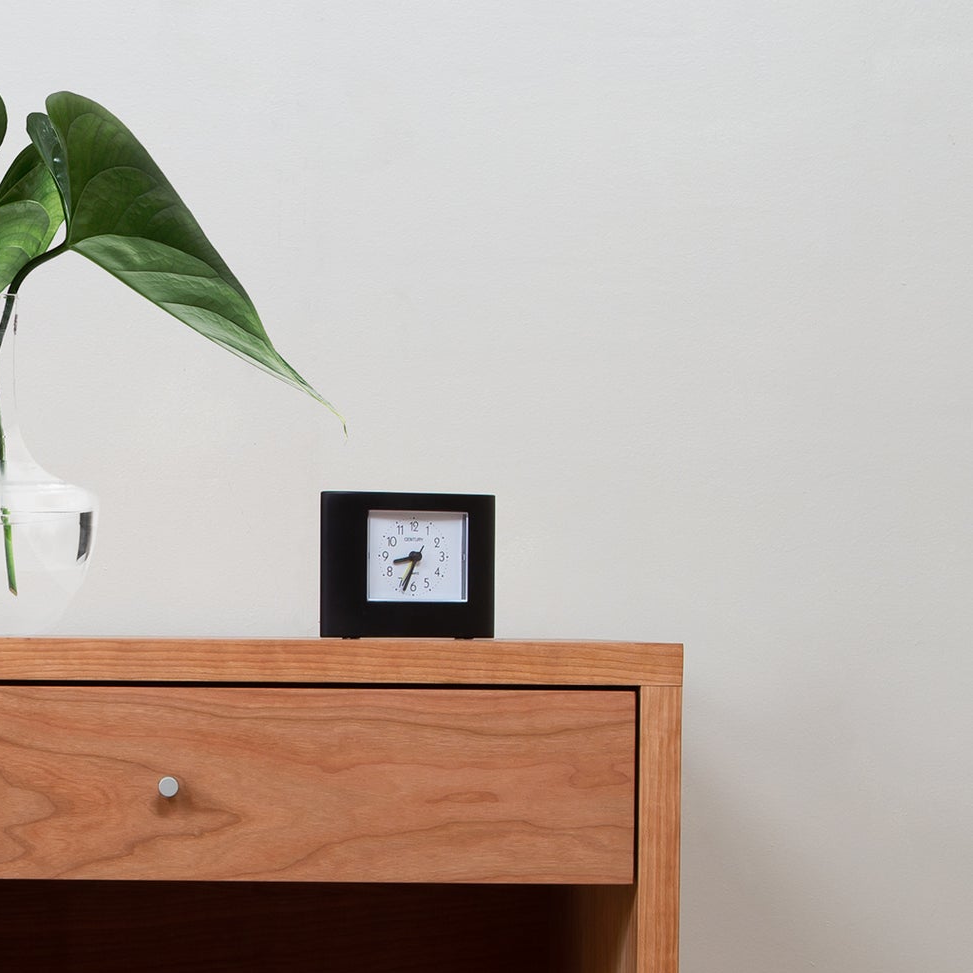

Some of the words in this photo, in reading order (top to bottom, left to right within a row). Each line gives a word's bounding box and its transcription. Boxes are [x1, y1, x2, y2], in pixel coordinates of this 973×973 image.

[397, 525, 404, 535] 11
[410, 521, 419, 532] 12
[426, 525, 430, 536] 1
[387, 536, 397, 547] 10
[434, 537, 440, 548] 2
[382, 551, 389, 562] 9
[439, 551, 445, 562] 3
[387, 566, 393, 577] 8
[434, 567, 440, 576] 4
[398, 577, 404, 588] 7
[410, 582, 417, 592] 6
[424, 578, 430, 588] 5
